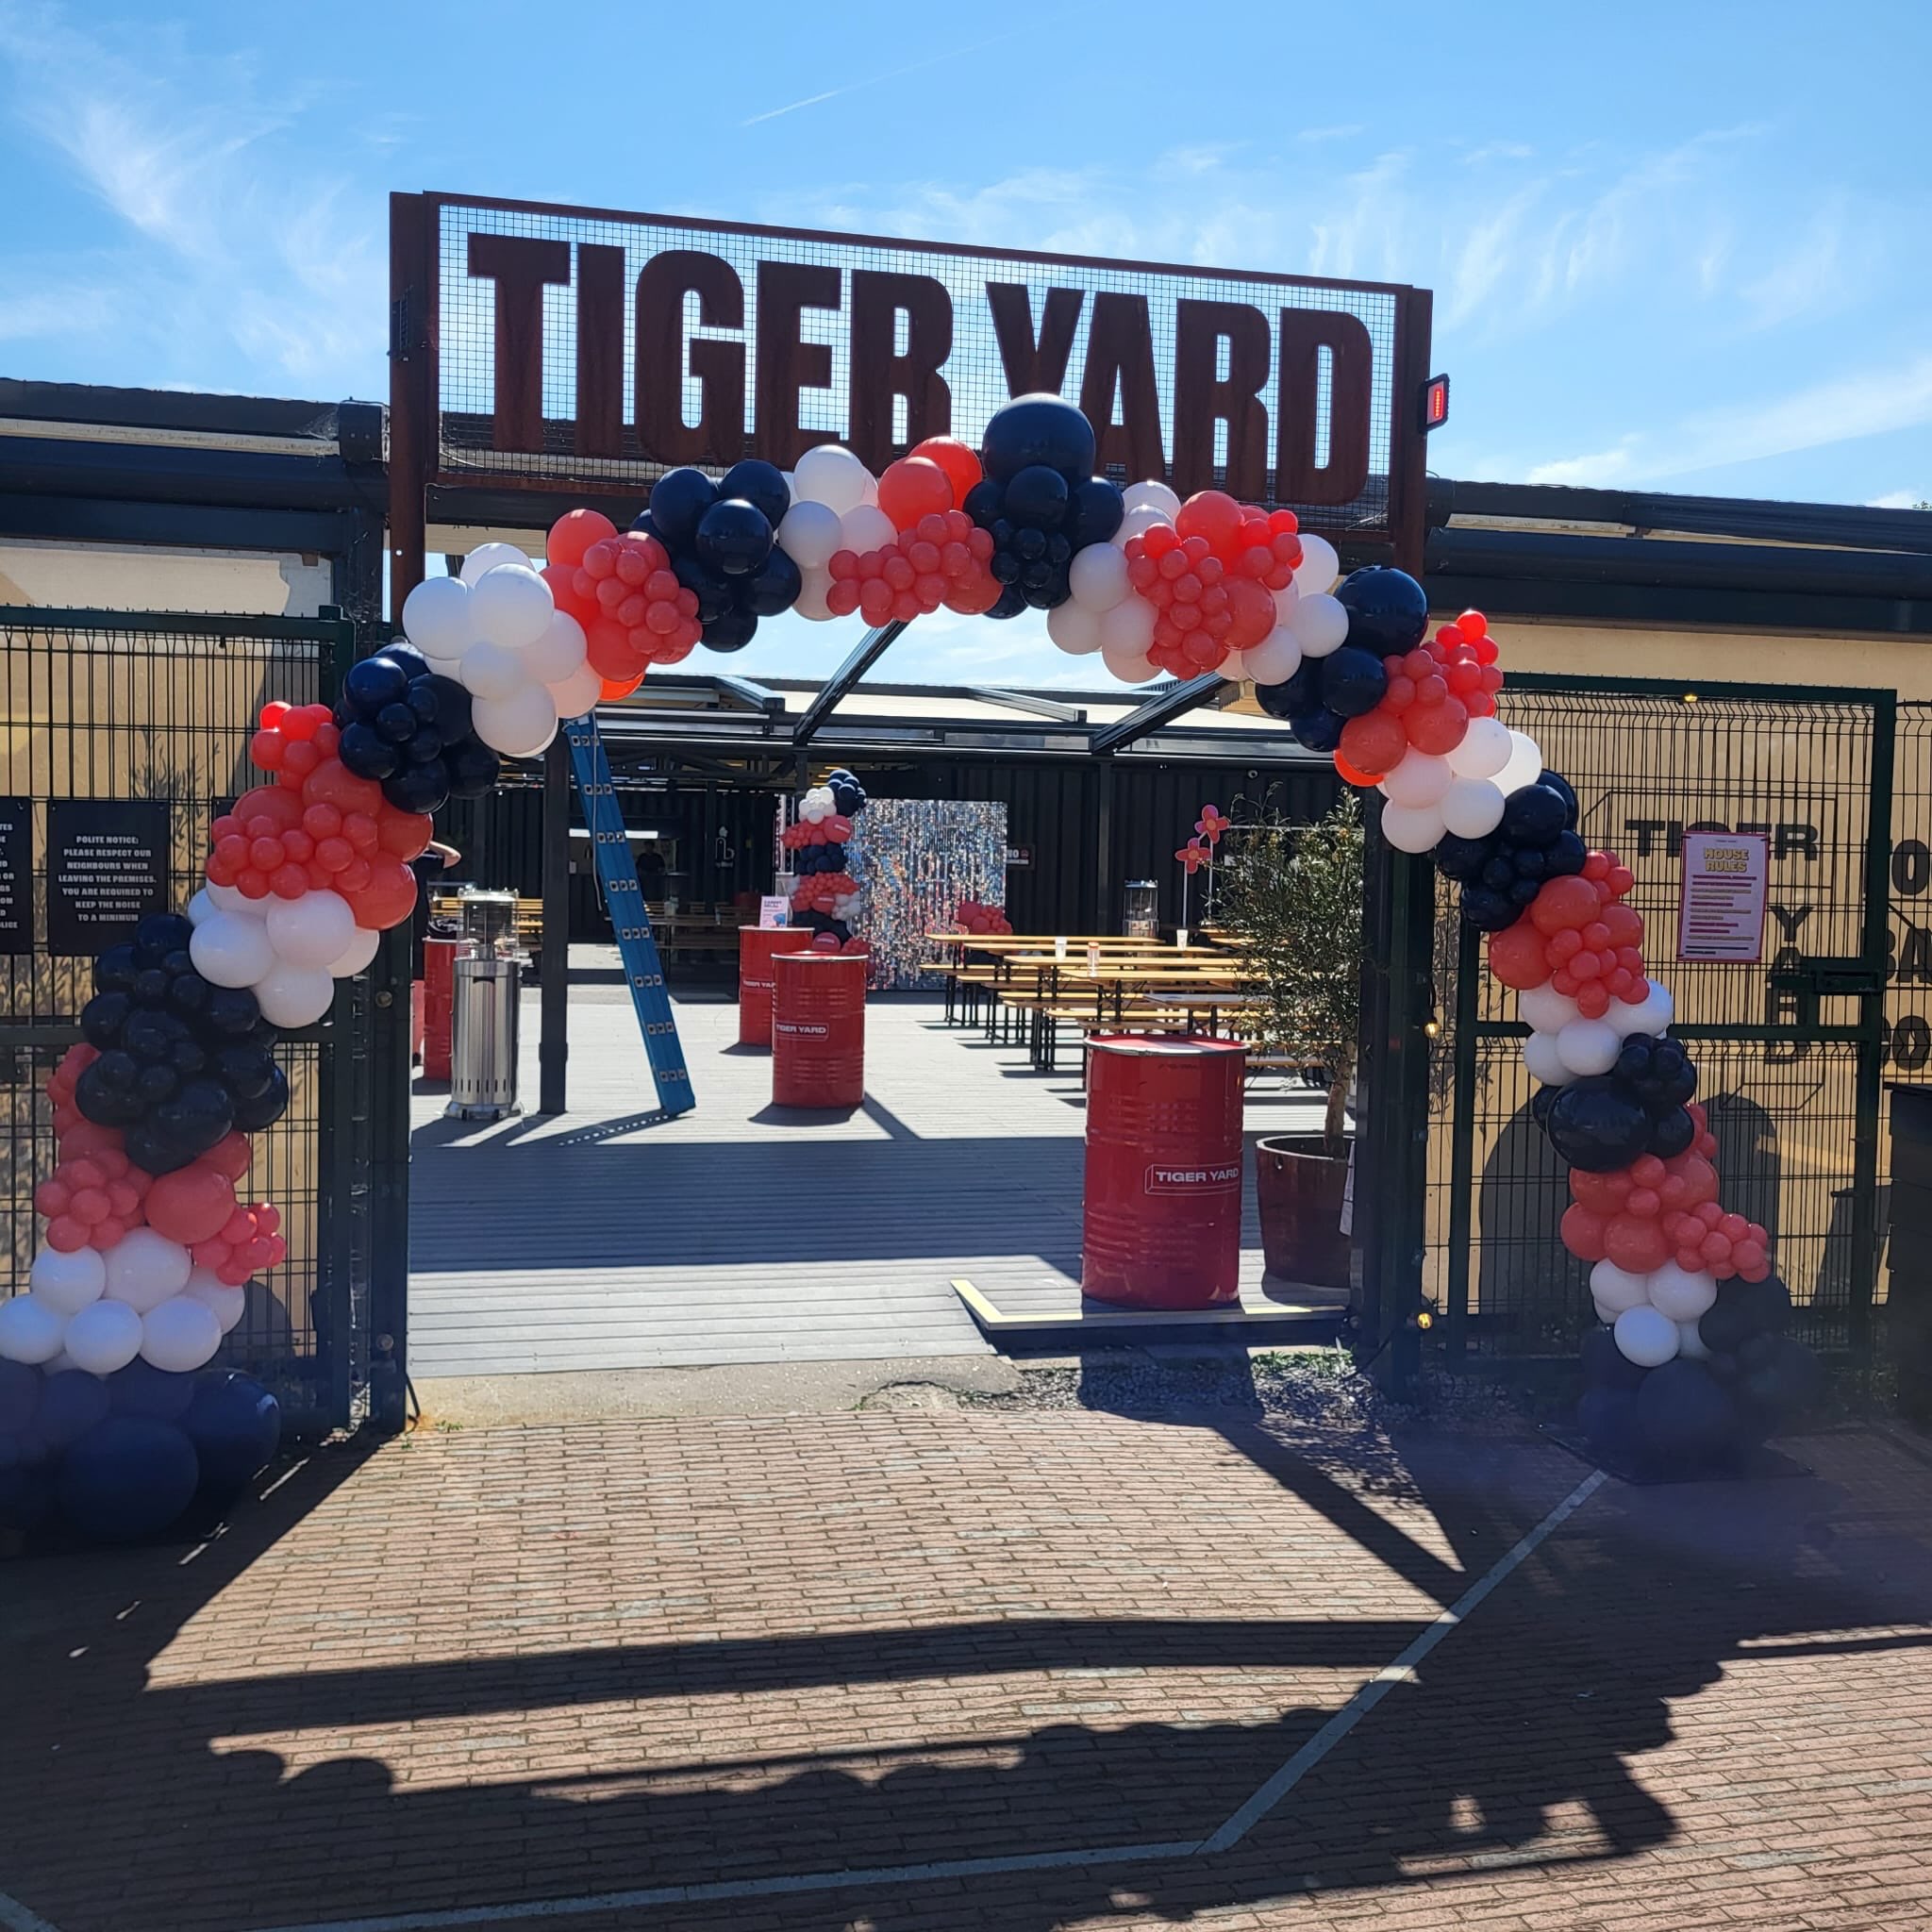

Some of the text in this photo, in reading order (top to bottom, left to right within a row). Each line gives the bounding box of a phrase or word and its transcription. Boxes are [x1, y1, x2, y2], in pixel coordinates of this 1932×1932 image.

[468, 232, 1373, 506] TIGER YARD
[1625, 820, 1818, 860] TIR
[63, 848, 94, 857] PLEASE
[134, 849, 151, 858] OUR
[1704, 847, 1749, 860] HOUSE
[67, 861, 121, 870] NEIGHBOURS
[1706, 860, 1747, 873] RULES
[95, 874, 111, 883] THE
[77, 913, 139, 922] TO A MINIMUM
[1156, 1168, 1239, 1182] TIGER YARD
